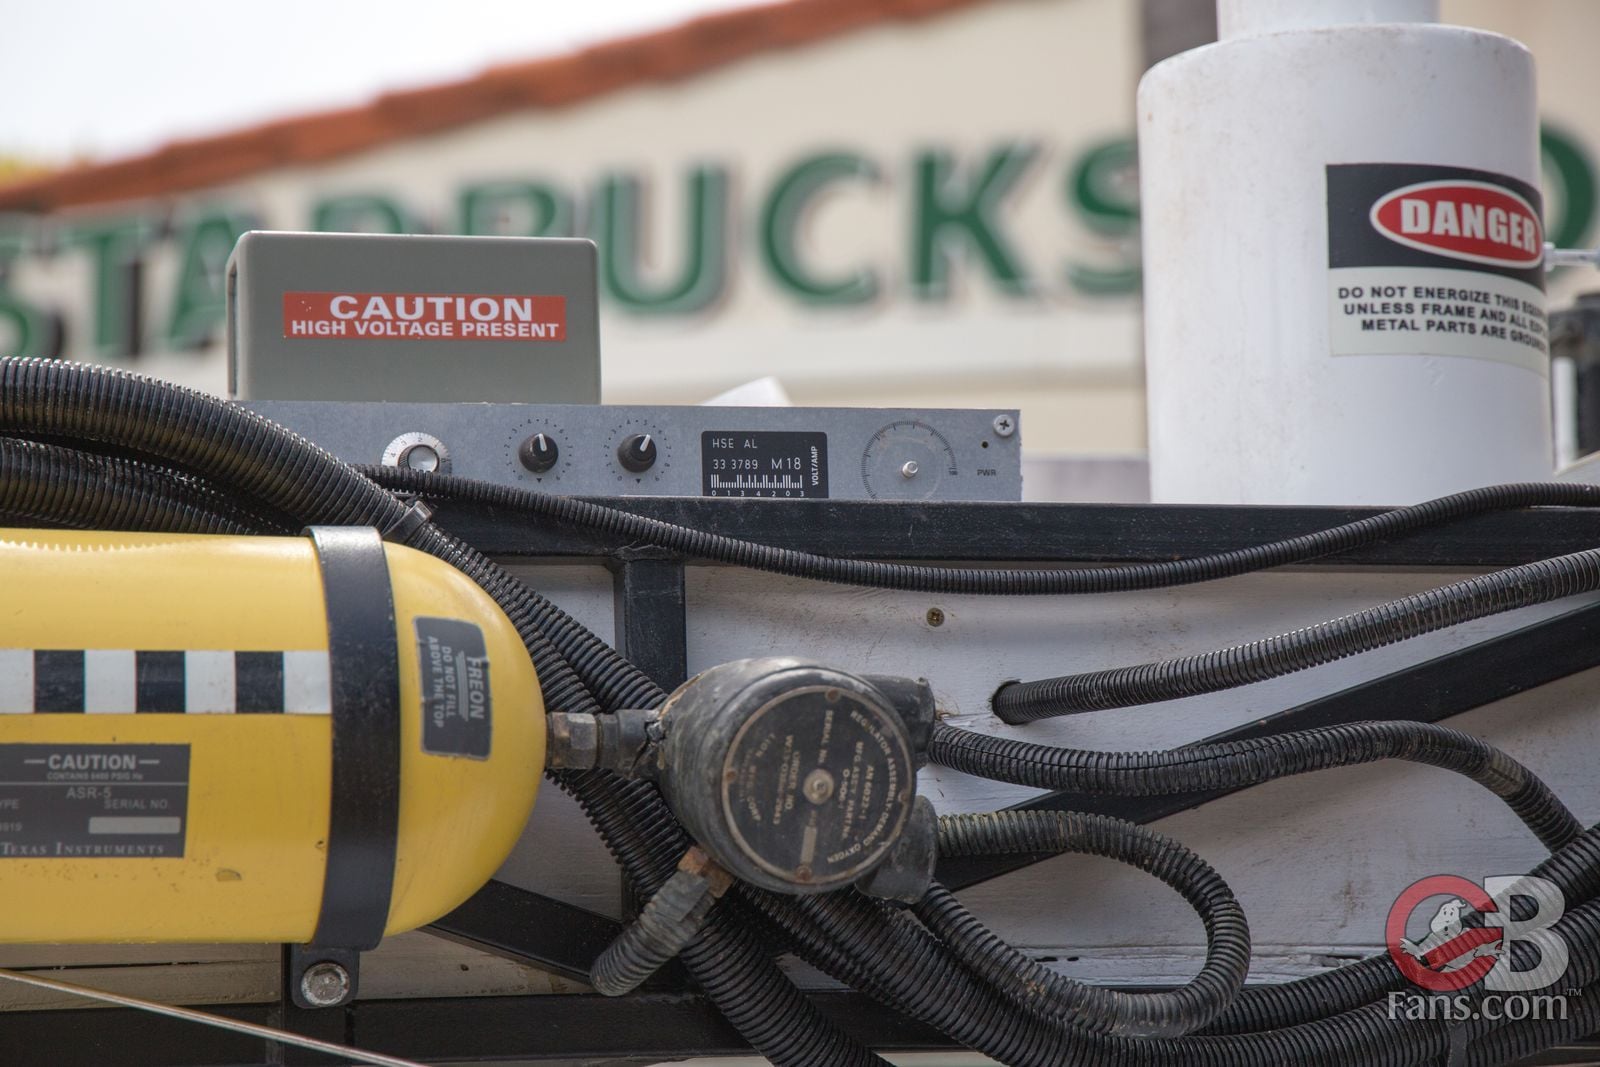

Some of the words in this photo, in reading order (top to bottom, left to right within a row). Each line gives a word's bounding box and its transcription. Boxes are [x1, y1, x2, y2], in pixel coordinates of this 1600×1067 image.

[1400, 198, 1537, 254] DANGER
[0, 138, 1139, 356] TAUCKS
[328, 295, 533, 322] CAUTION
[1338, 287, 1364, 299] DO
[1371, 286, 1407, 299] NOT
[1413, 286, 1491, 305] ENERGIZE
[1494, 294, 1519, 311] THIS
[291, 320, 346, 335] HIGH
[354, 321, 454, 337] VOLTAGE
[461, 322, 560, 338] PRESENT
[1344, 303, 1415, 315] UNLESS
[1421, 303, 1476, 318] FRAME
[1480, 308, 1506, 323] AND
[1509, 314, 1527, 330] ALL
[1361, 319, 1420, 331] METAL
[1426, 319, 1476, 335] PARTS
[1480, 324, 1507, 340] ARE
[712, 438, 735, 449] HSE
[743, 438, 758, 449] AL
[713, 459, 726, 470] 33
[731, 459, 758, 470] 3789
[810, 446, 819, 486] VOLT/AMP
[427, 635, 443, 674] ABOVE
[441, 645, 453, 662] DO
[433, 677, 445, 699] THE
[443, 665, 456, 690] NOT
[466, 656, 486, 720] FREON
[433, 704, 445, 729] TOP
[445, 693, 457, 718] FILL
[821, 709, 834, 743] SERIAL
[48, 754, 137, 770] CAUTION
[66, 786, 112, 799] ASR-5
[103, 799, 146, 809] SERIAL
